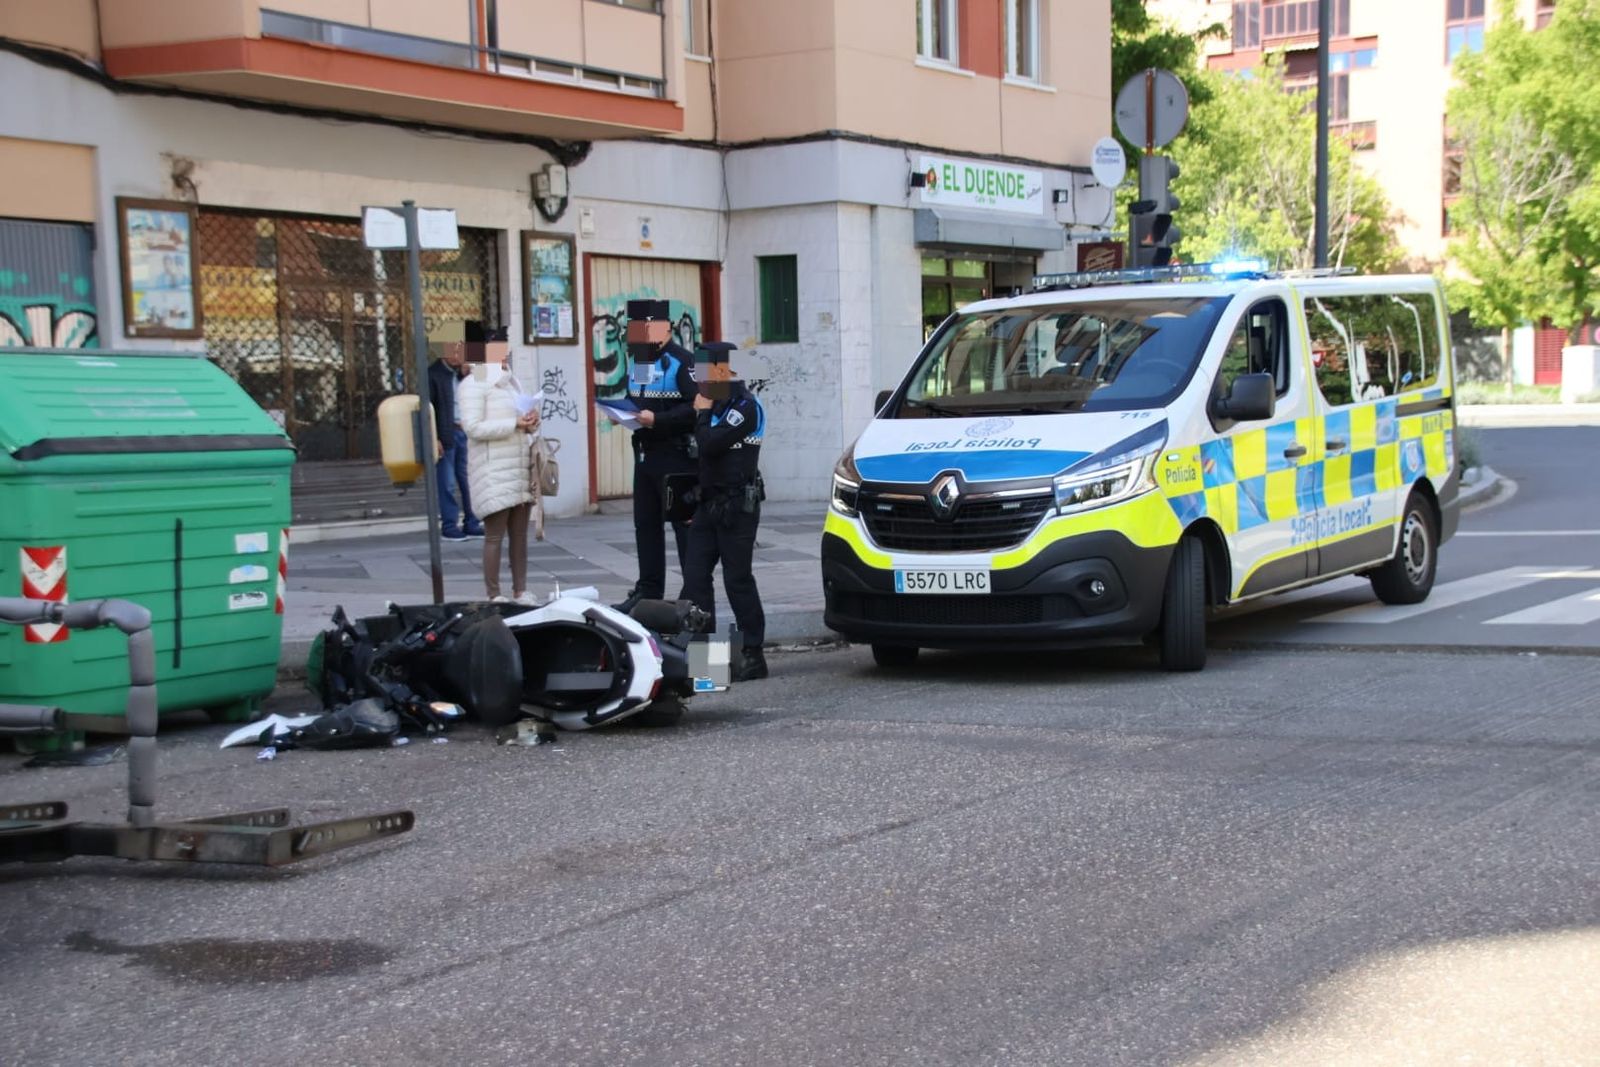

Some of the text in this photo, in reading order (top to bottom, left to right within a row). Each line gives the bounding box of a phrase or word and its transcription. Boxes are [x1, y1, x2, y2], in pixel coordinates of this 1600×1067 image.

[943, 164, 960, 191] EL
[965, 166, 1025, 200] DUENDE
[906, 572, 986, 590] 5570 LRC
